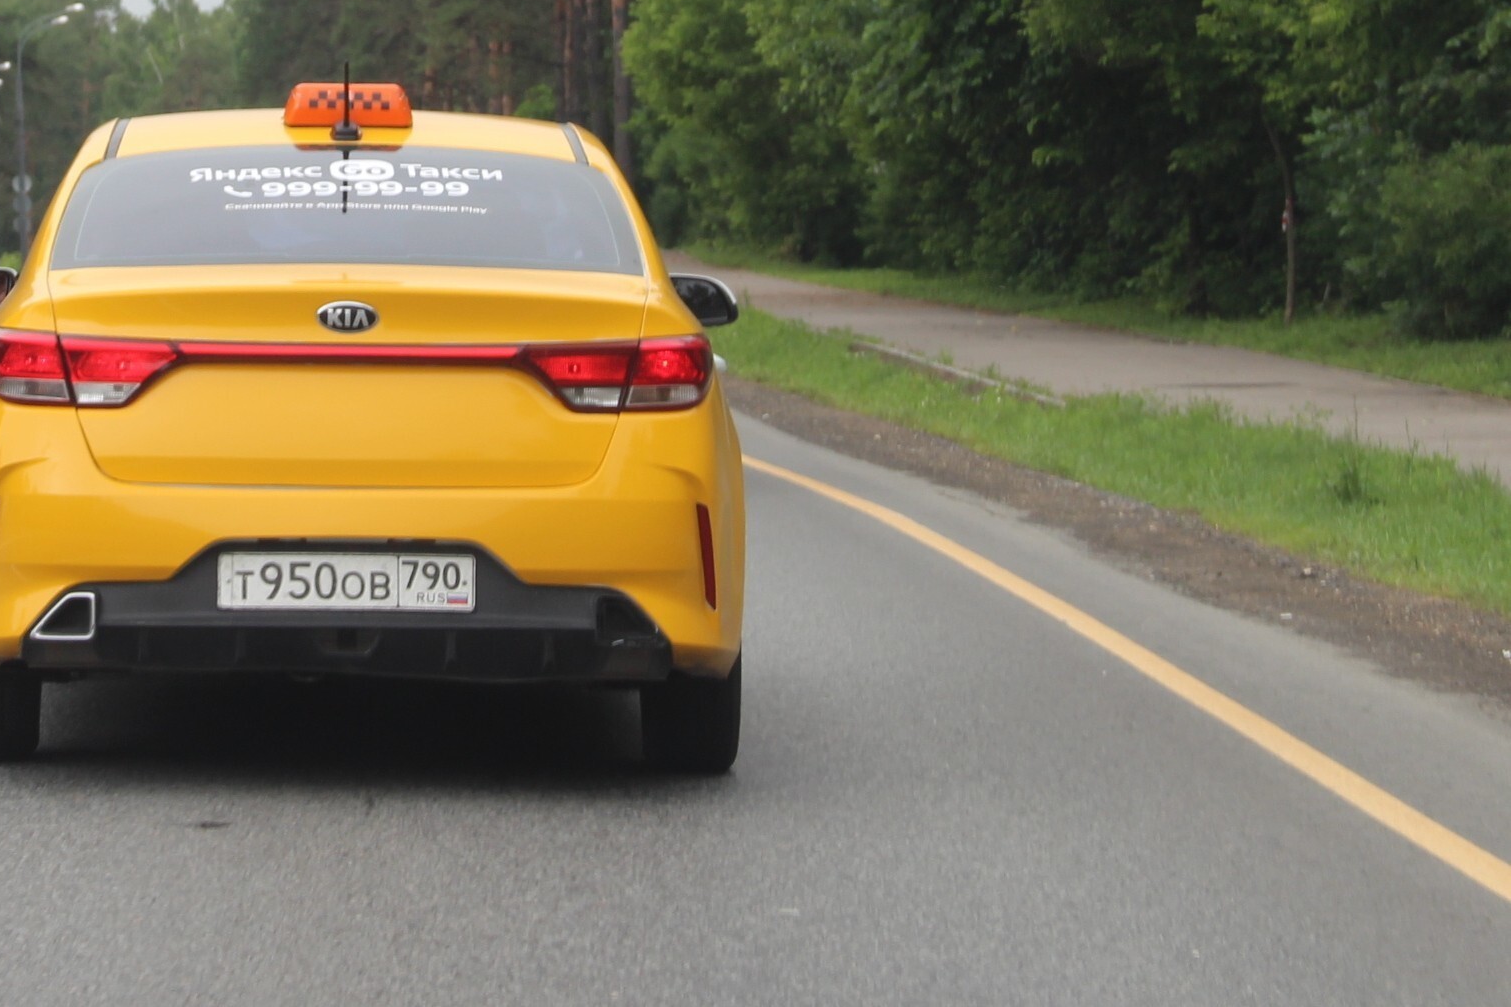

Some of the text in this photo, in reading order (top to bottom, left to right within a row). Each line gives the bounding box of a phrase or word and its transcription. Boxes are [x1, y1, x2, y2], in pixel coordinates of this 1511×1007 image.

[189, 165, 323, 182] Яндекс
[400, 163, 503, 181] Такси
[261, 180, 469, 197] 999-99-99
[225, 201, 303, 210] Скачивайте
[317, 201, 344, 210] App
[346, 201, 381, 210] Store
[384, 202, 409, 210] или
[411, 203, 458, 213] Google
[461, 205, 488, 214] Play
[327, 307, 369, 328] KIA
[235, 561, 461, 600] Т950ОВ 790
[417, 592, 446, 603] RUS
